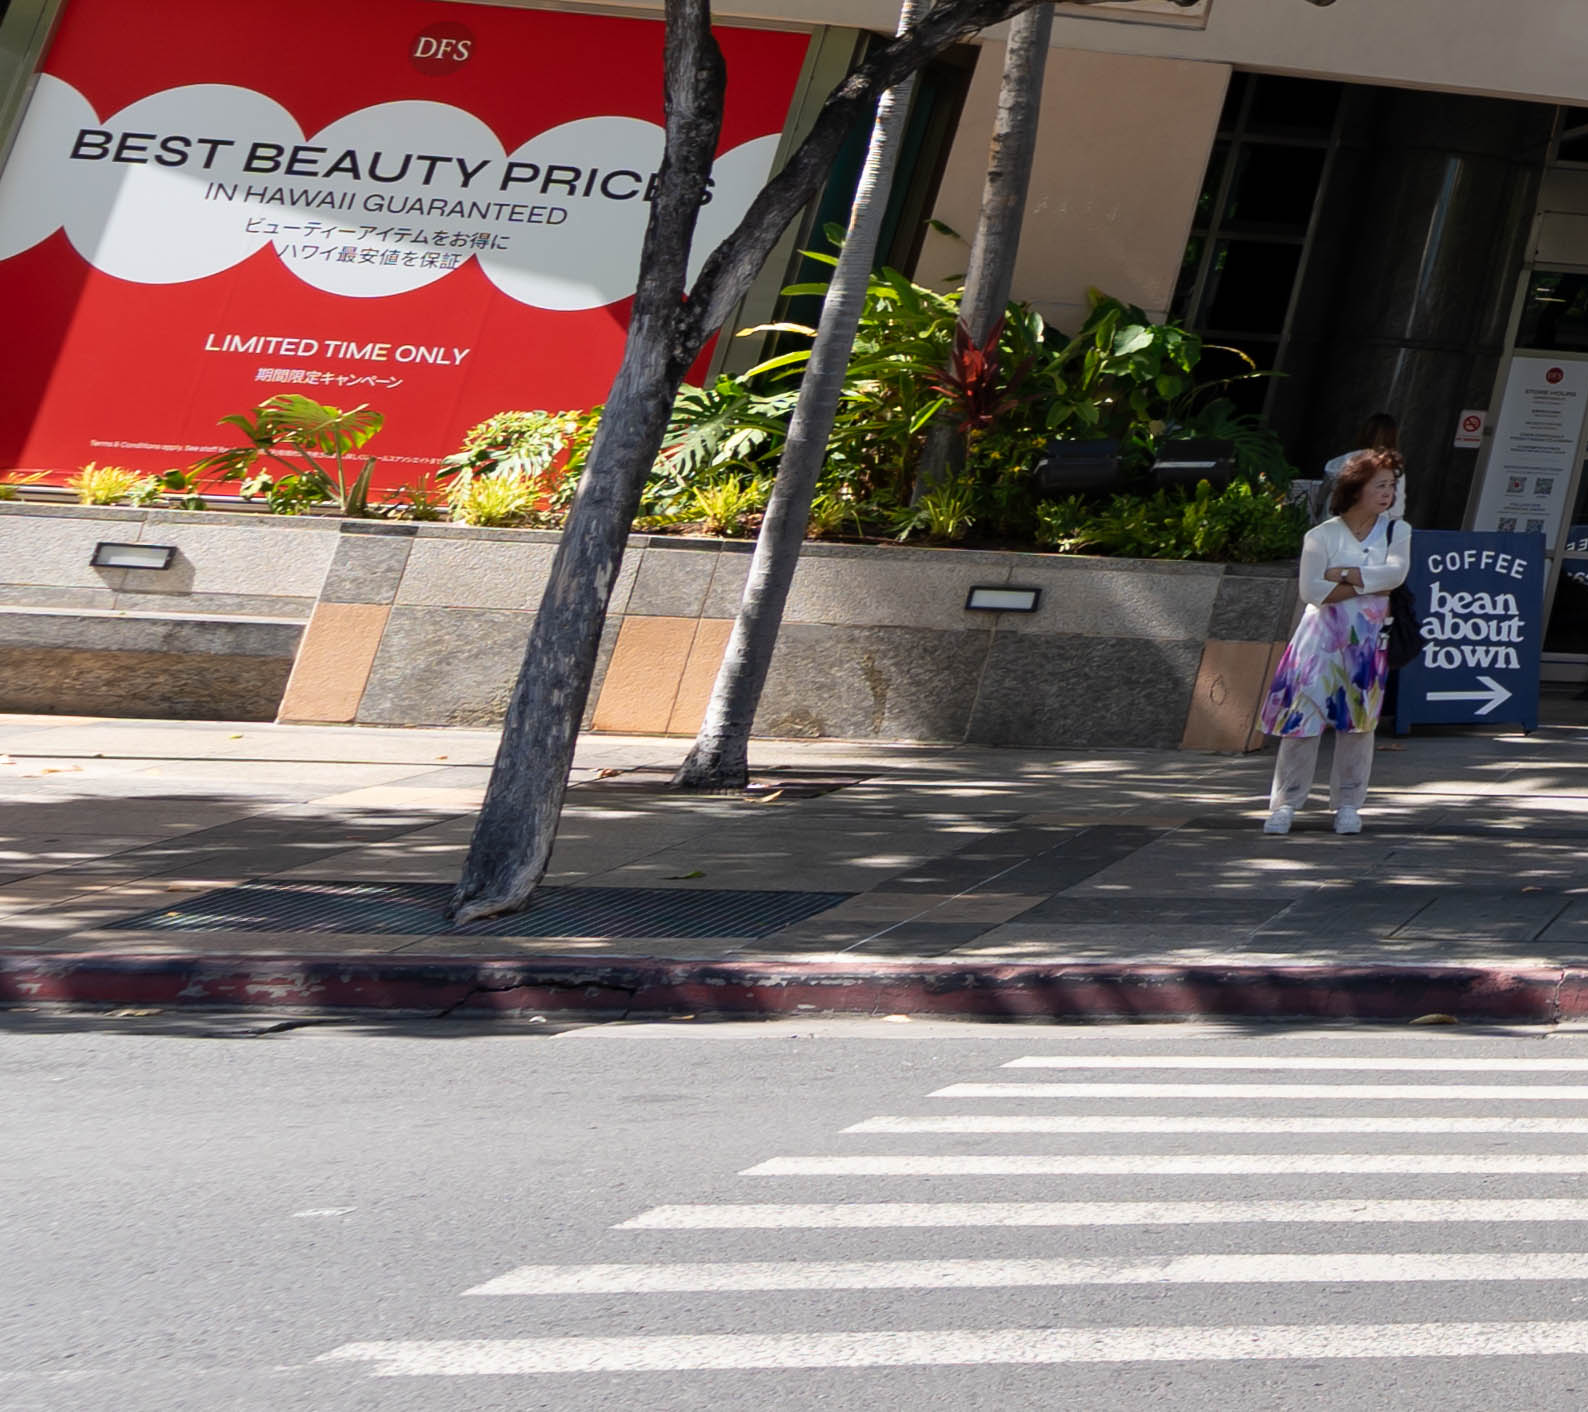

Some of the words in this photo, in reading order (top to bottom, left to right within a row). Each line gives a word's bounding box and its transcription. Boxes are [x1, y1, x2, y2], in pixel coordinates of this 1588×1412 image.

[413, 36, 472, 62] DFS
[69, 128, 235, 169] BEST
[242, 141, 492, 189] BEAUTY
[204, 181, 238, 202] IN
[243, 184, 356, 211] HAWAII
[363, 192, 568, 226] GUARANTEED
[244, 217, 510, 250] ビューティーアイテムをお得に
[277, 243, 463, 270] ハワイ最安値を保証
[204, 333, 318, 357] LIMITED
[324, 340, 392, 361] TIME
[394, 344, 471, 366] ONLY
[254, 367, 404, 389] 期間限定キャンペーン
[1427, 549, 1528, 580] COFFEE
[1429, 580, 1520, 615] bean
[1419, 611, 1526, 643] about
[1422, 640, 1521, 670] town
